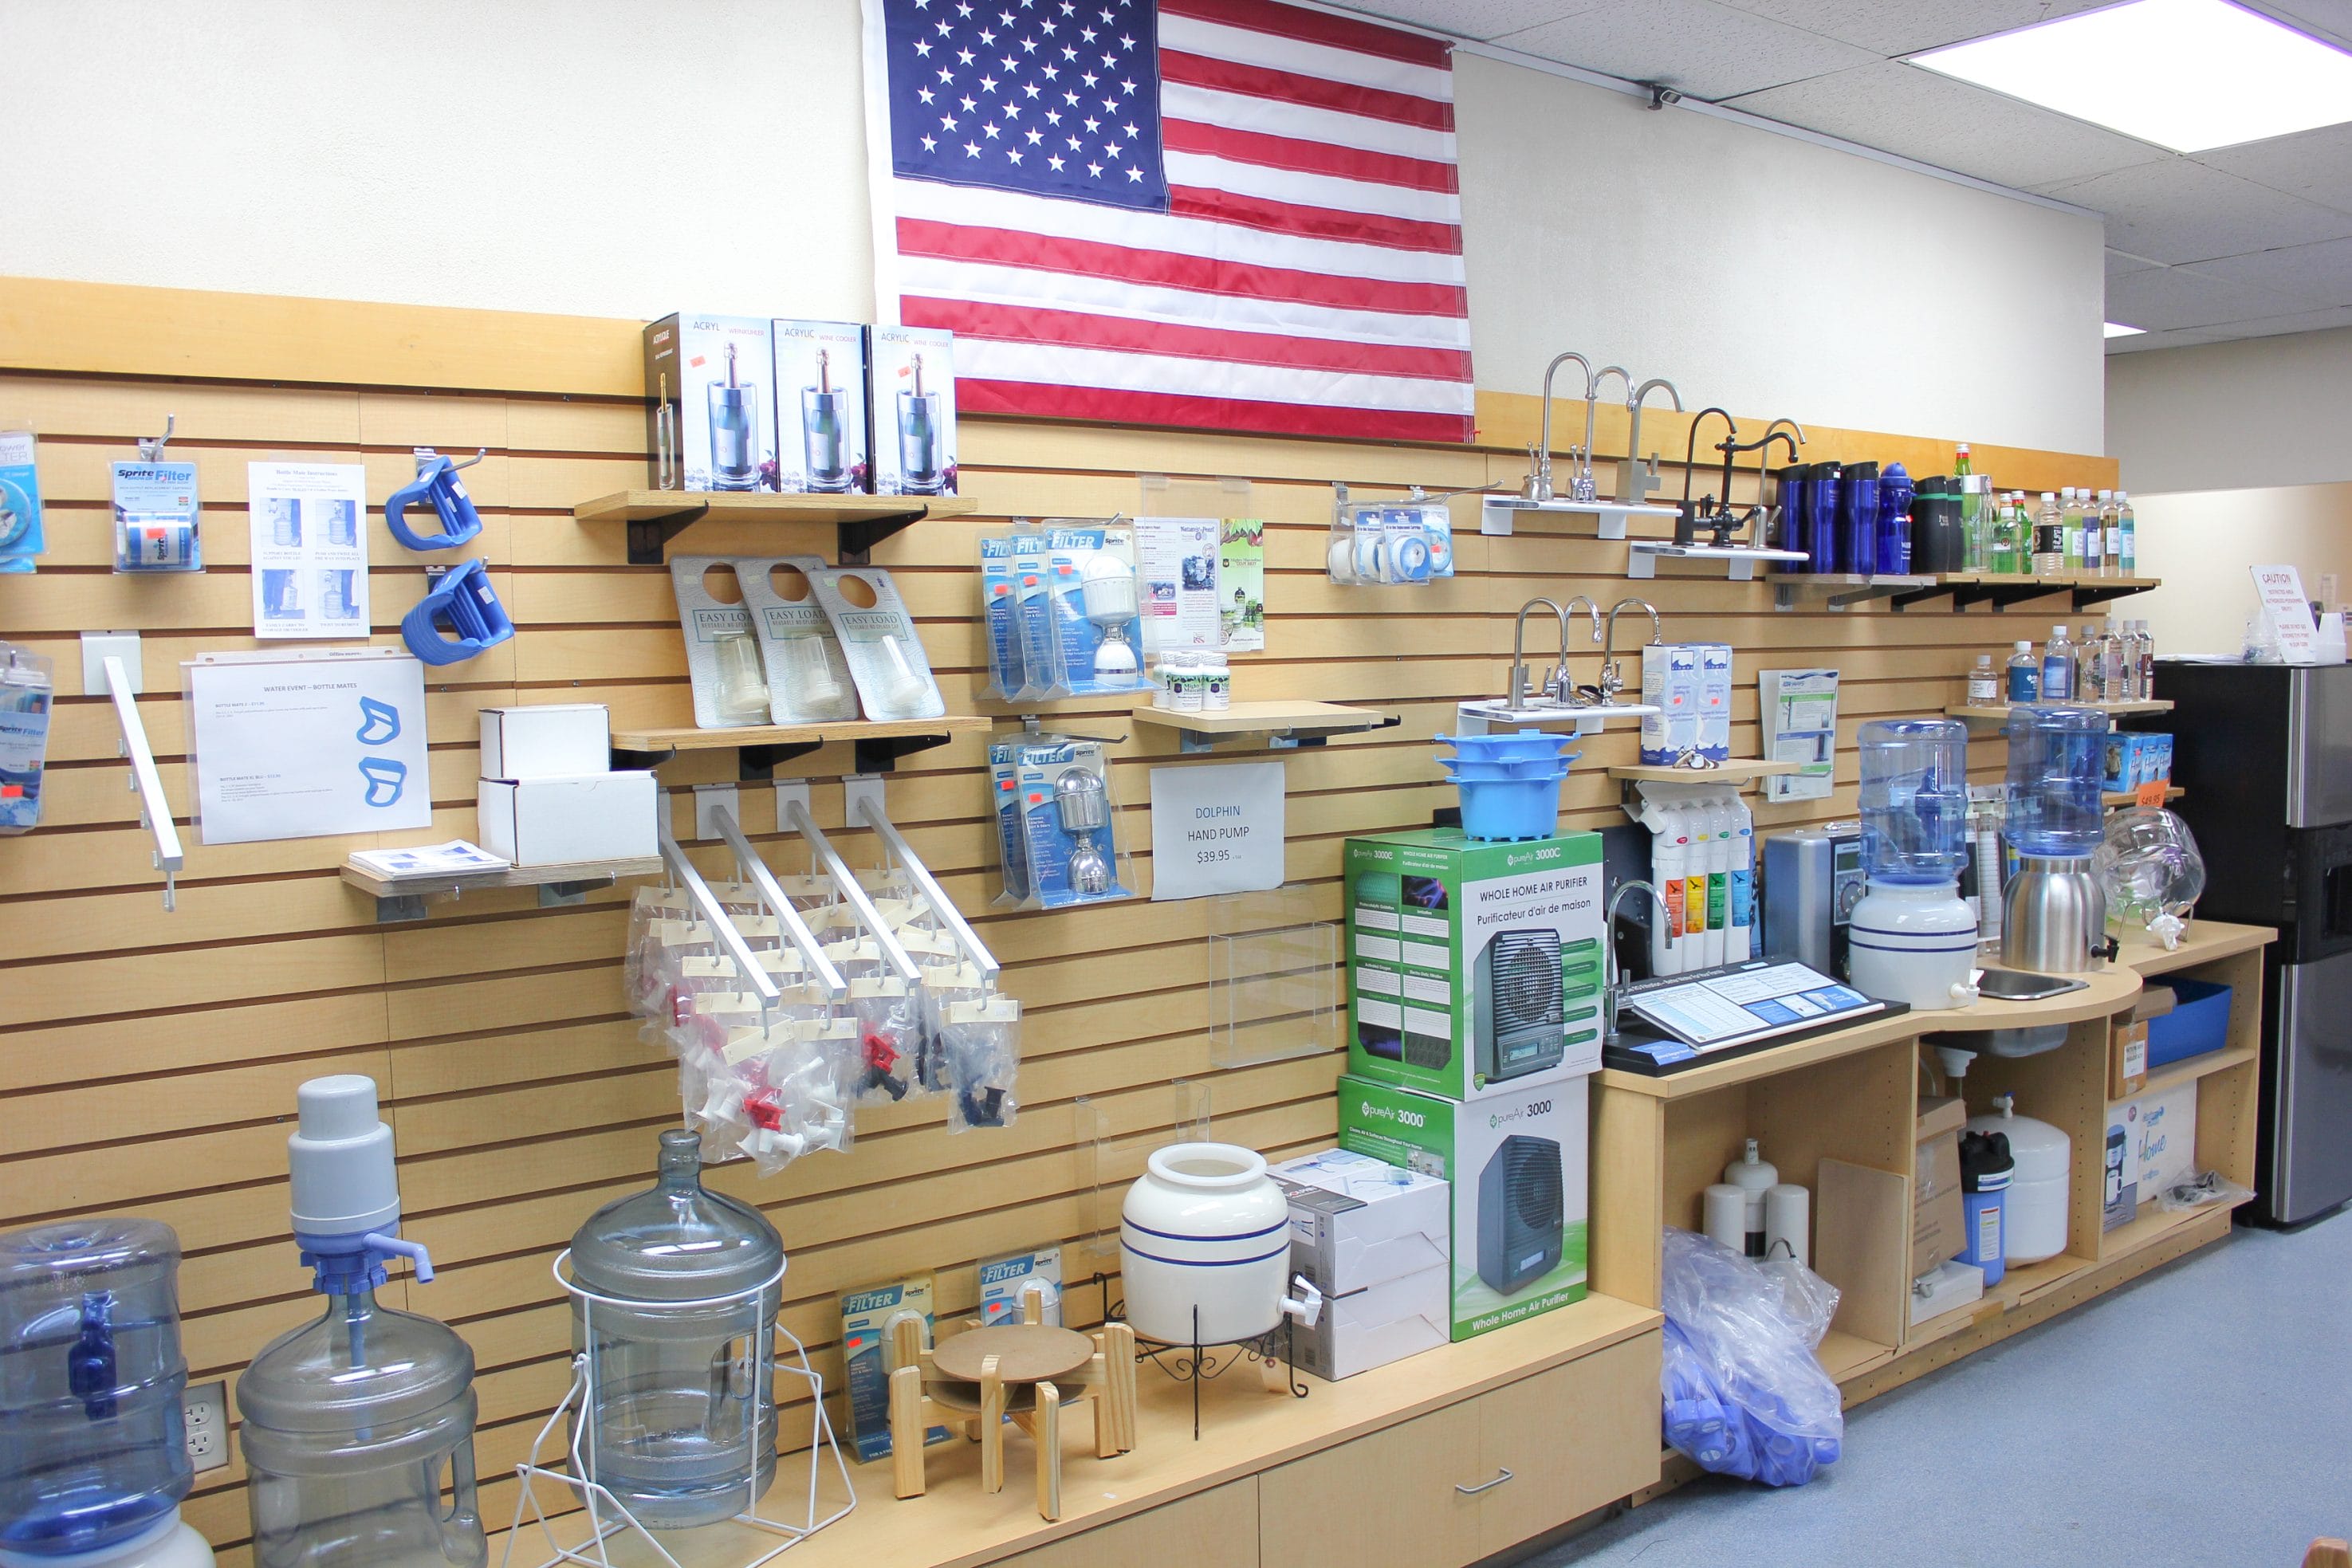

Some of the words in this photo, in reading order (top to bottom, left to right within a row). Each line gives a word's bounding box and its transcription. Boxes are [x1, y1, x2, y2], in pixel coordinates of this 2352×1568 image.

[693, 321, 721, 332] ACRYL
[785, 328, 815, 339] ACRYLIC
[881, 332, 910, 344] ACRYLIC
[929, 340, 949, 348] COOLER
[117, 469, 155, 479] Sprite
[155, 470, 191, 481] Filter
[157, 536, 167, 561] Sprit
[1050, 535, 1095, 549] FILTER
[2262, 573, 2291, 584] CAUTION
[699, 611, 727, 623] EASY
[730, 611, 754, 622] LOA
[769, 610, 794, 621] EASY
[796, 609, 827, 620] LOAD
[844, 615, 871, 625] EASY
[871, 615, 898, 625] LOAD
[1022, 751, 1065, 764] FILTER
[1196, 805, 1241, 819] DOLPHIN
[1188, 828, 1217, 842] HAND
[1219, 826, 1250, 839] PUMP
[1197, 849, 1230, 865] $39.95
[1374, 850, 1394, 860] 3000C
[1513, 851, 1534, 866] pureAir
[1535, 847, 1562, 861] 3000C
[1480, 888, 1511, 902] WHOLE
[1512, 884, 1538, 898] HOME
[1540, 880, 1554, 894] AIR
[1556, 876, 1588, 890] PURIFIER
[1477, 910, 1525, 925] Purificateur
[1528, 906, 1546, 918] d'air
[1548, 903, 1559, 914] de
[1561, 899, 1591, 913] maison
[1369, 1106, 1395, 1122] pureAir
[1398, 1109, 1424, 1128] 3000
[1497, 1107, 1525, 1128] pureAir
[1527, 1099, 1552, 1118] 3000
[1034, 1258, 1052, 1267] Sprite
[985, 1263, 1025, 1283] FILTER
[905, 1287, 924, 1297] Sprite
[848, 1293, 894, 1314] FILTER
[1472, 1315, 1500, 1330] Whole
[1501, 1307, 1527, 1322] Home
[1528, 1300, 1540, 1313] Air
[1541, 1292, 1569, 1308] Purifier
